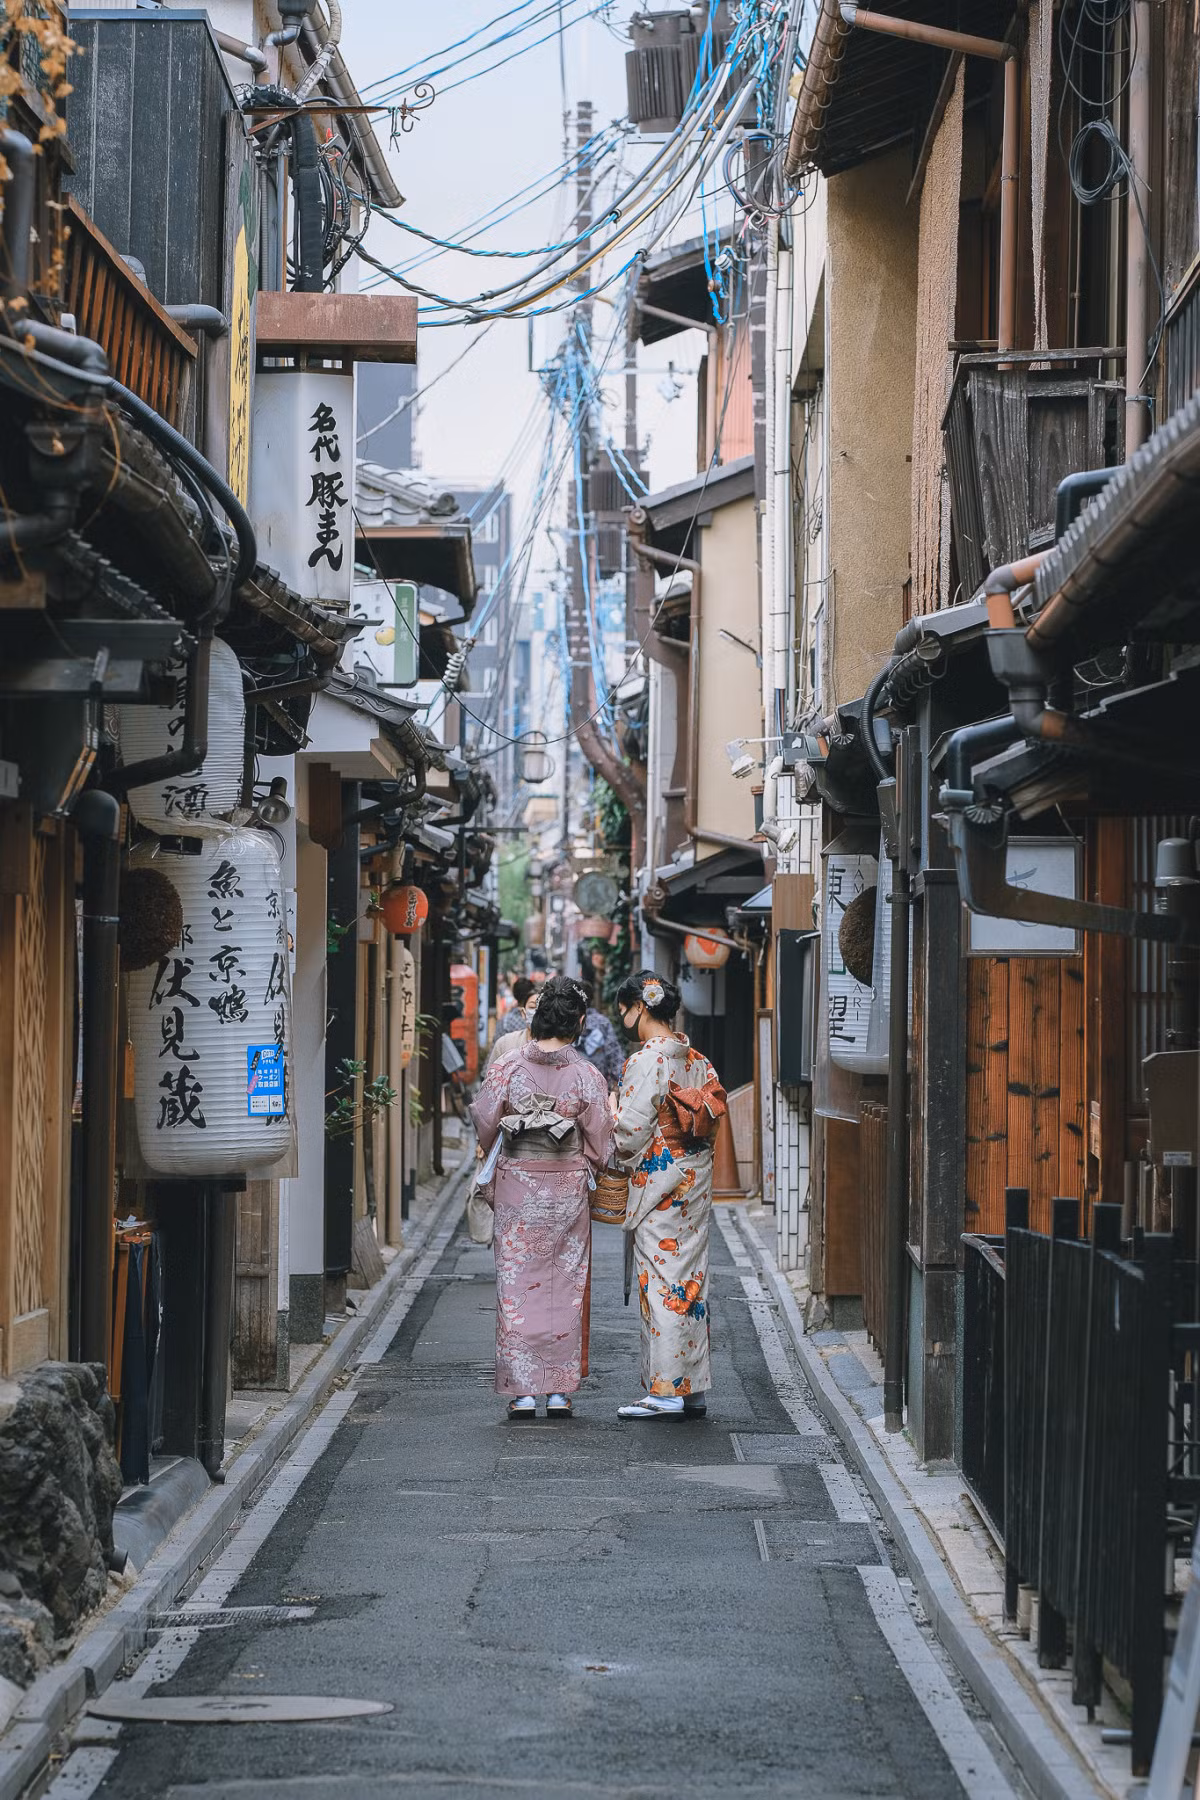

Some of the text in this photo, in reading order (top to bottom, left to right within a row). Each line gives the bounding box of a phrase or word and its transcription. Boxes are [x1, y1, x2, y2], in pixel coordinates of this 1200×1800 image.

[305, 402, 349, 572] 名代豚まん
[203, 860, 250, 1025] 魚と京鴨
